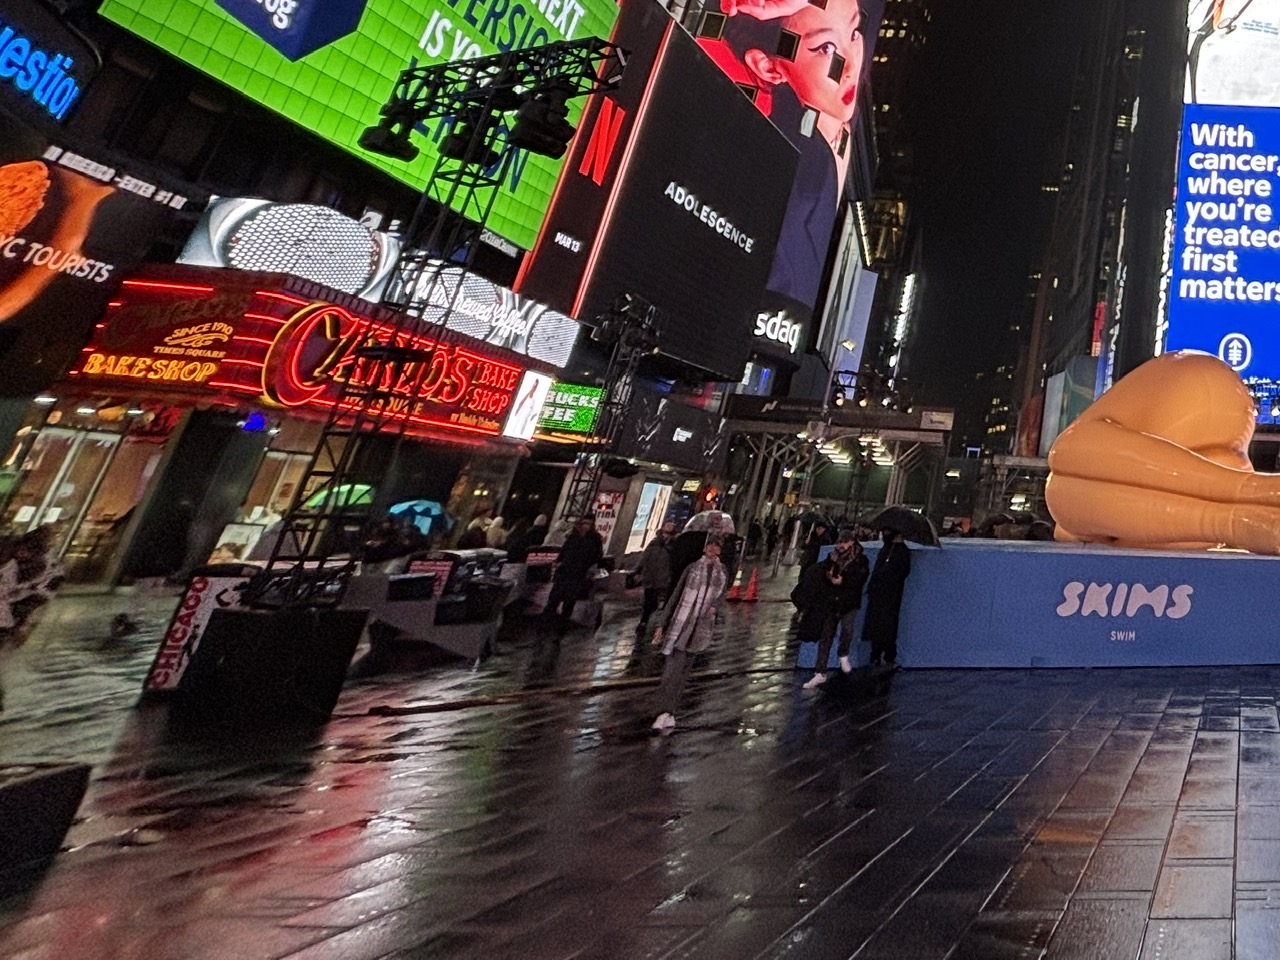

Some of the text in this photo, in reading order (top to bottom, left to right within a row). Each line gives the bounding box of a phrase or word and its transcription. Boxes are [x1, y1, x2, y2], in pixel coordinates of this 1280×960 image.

[418, 9, 453, 59] IS
[1190, 122, 1254, 148] With
[1187, 171, 1272, 197] where
[664, 181, 754, 254] ADOLESCENCE
[1185, 198, 1272, 224] you're
[554, 231, 581, 253] MAR 13
[23, 242, 114, 283] TOURISTS
[1182, 247, 1238, 272] first
[171, 321, 234, 337] SINCE 1910
[753, 310, 802, 354] sdaq
[153, 345, 227, 359] TIMES SQUARE
[479, 363, 520, 391] BAKE
[470, 387, 509, 414] SHOP
[1056, 581, 1194, 619] SKIMS
[149, 575, 209, 688] CHICAGO
[1110, 630, 1136, 641] SWIM
